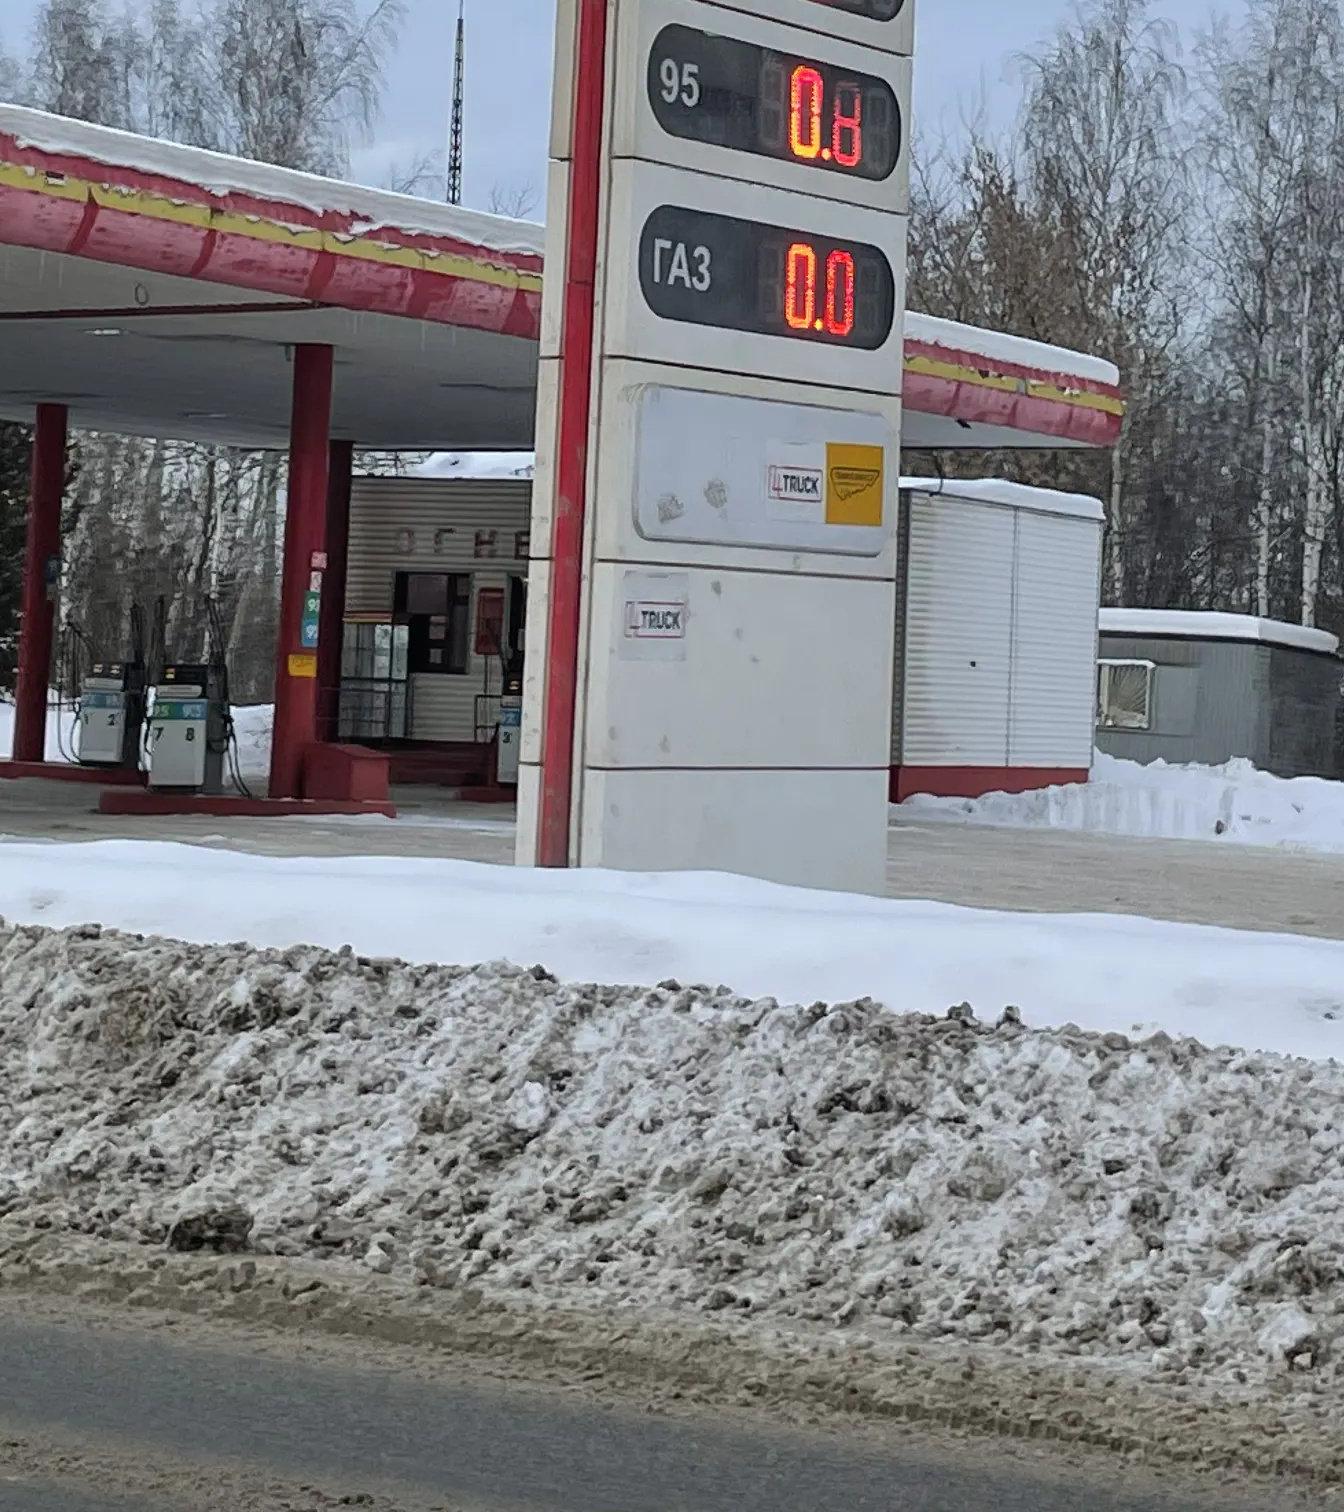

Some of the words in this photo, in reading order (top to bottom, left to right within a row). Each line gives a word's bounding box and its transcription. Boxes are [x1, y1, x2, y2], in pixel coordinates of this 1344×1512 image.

[660, 58, 700, 107] 95
[653, 238, 712, 292] ГАЗ
[783, 474, 819, 495] TRUCK
[641, 610, 681, 630] TRUCK
[154, 727, 164, 741] 7
[186, 727, 195, 741] 8
